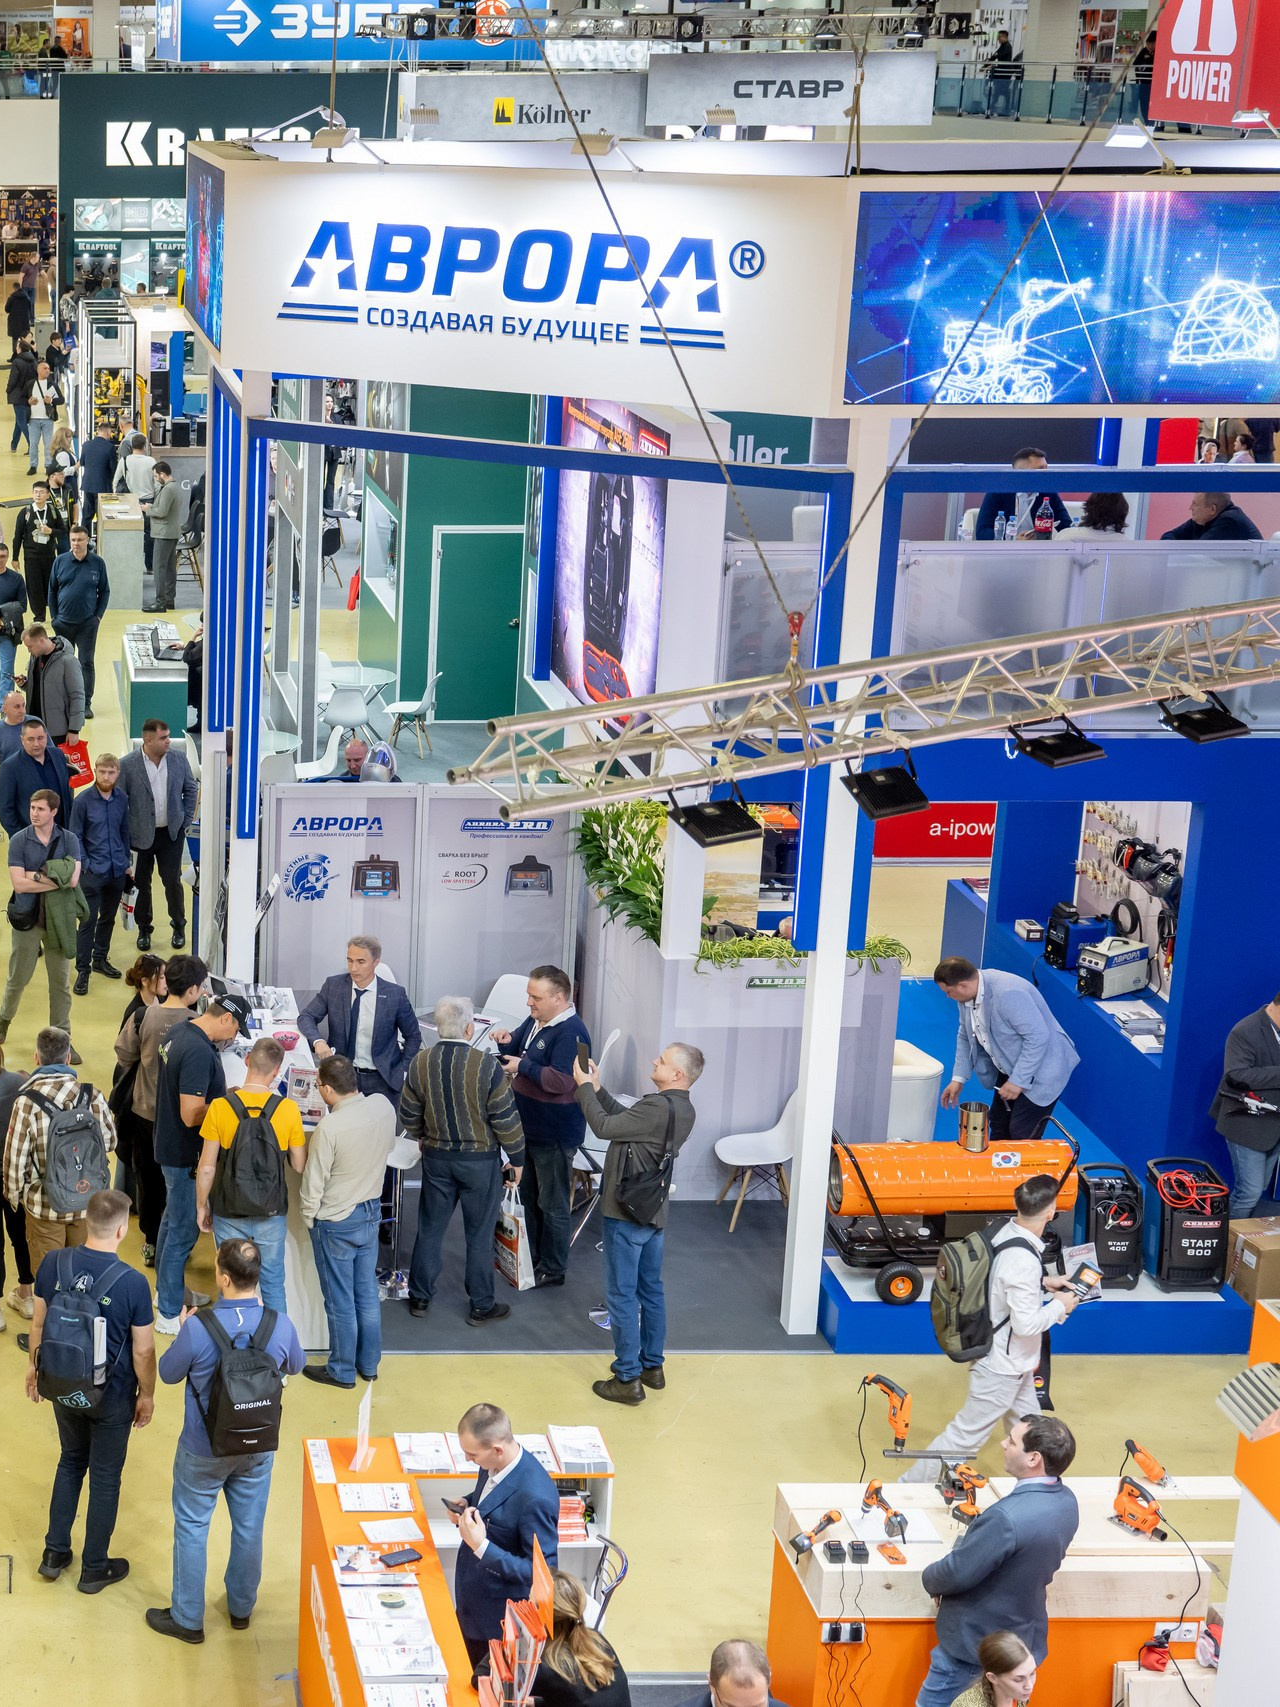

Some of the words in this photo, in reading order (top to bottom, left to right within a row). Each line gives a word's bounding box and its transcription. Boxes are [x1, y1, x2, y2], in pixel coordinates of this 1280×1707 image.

[270, 3, 434, 39] ЗУБ
[733, 79, 844, 99] СТАВР
[1165, 59, 1232, 102] POWER
[517, 103, 591, 124] Kölner
[78, 242, 117, 250] KRAFTOOL
[291, 220, 722, 313] АВРОРА
[367, 307, 493, 334] СОЗДАВАЯ
[501, 316, 630, 346] БУДУЩЕЕ
[292, 817, 383, 831] АВРОРА
[506, 821, 549, 830] PRO
[284, 854, 310, 883] ЧЕСТНЫЕ
[1112, 950, 1141, 965] АВРОРА
[1181, 1239, 1218, 1248] START
[234, 1399, 272, 1411] ORIGINAL
